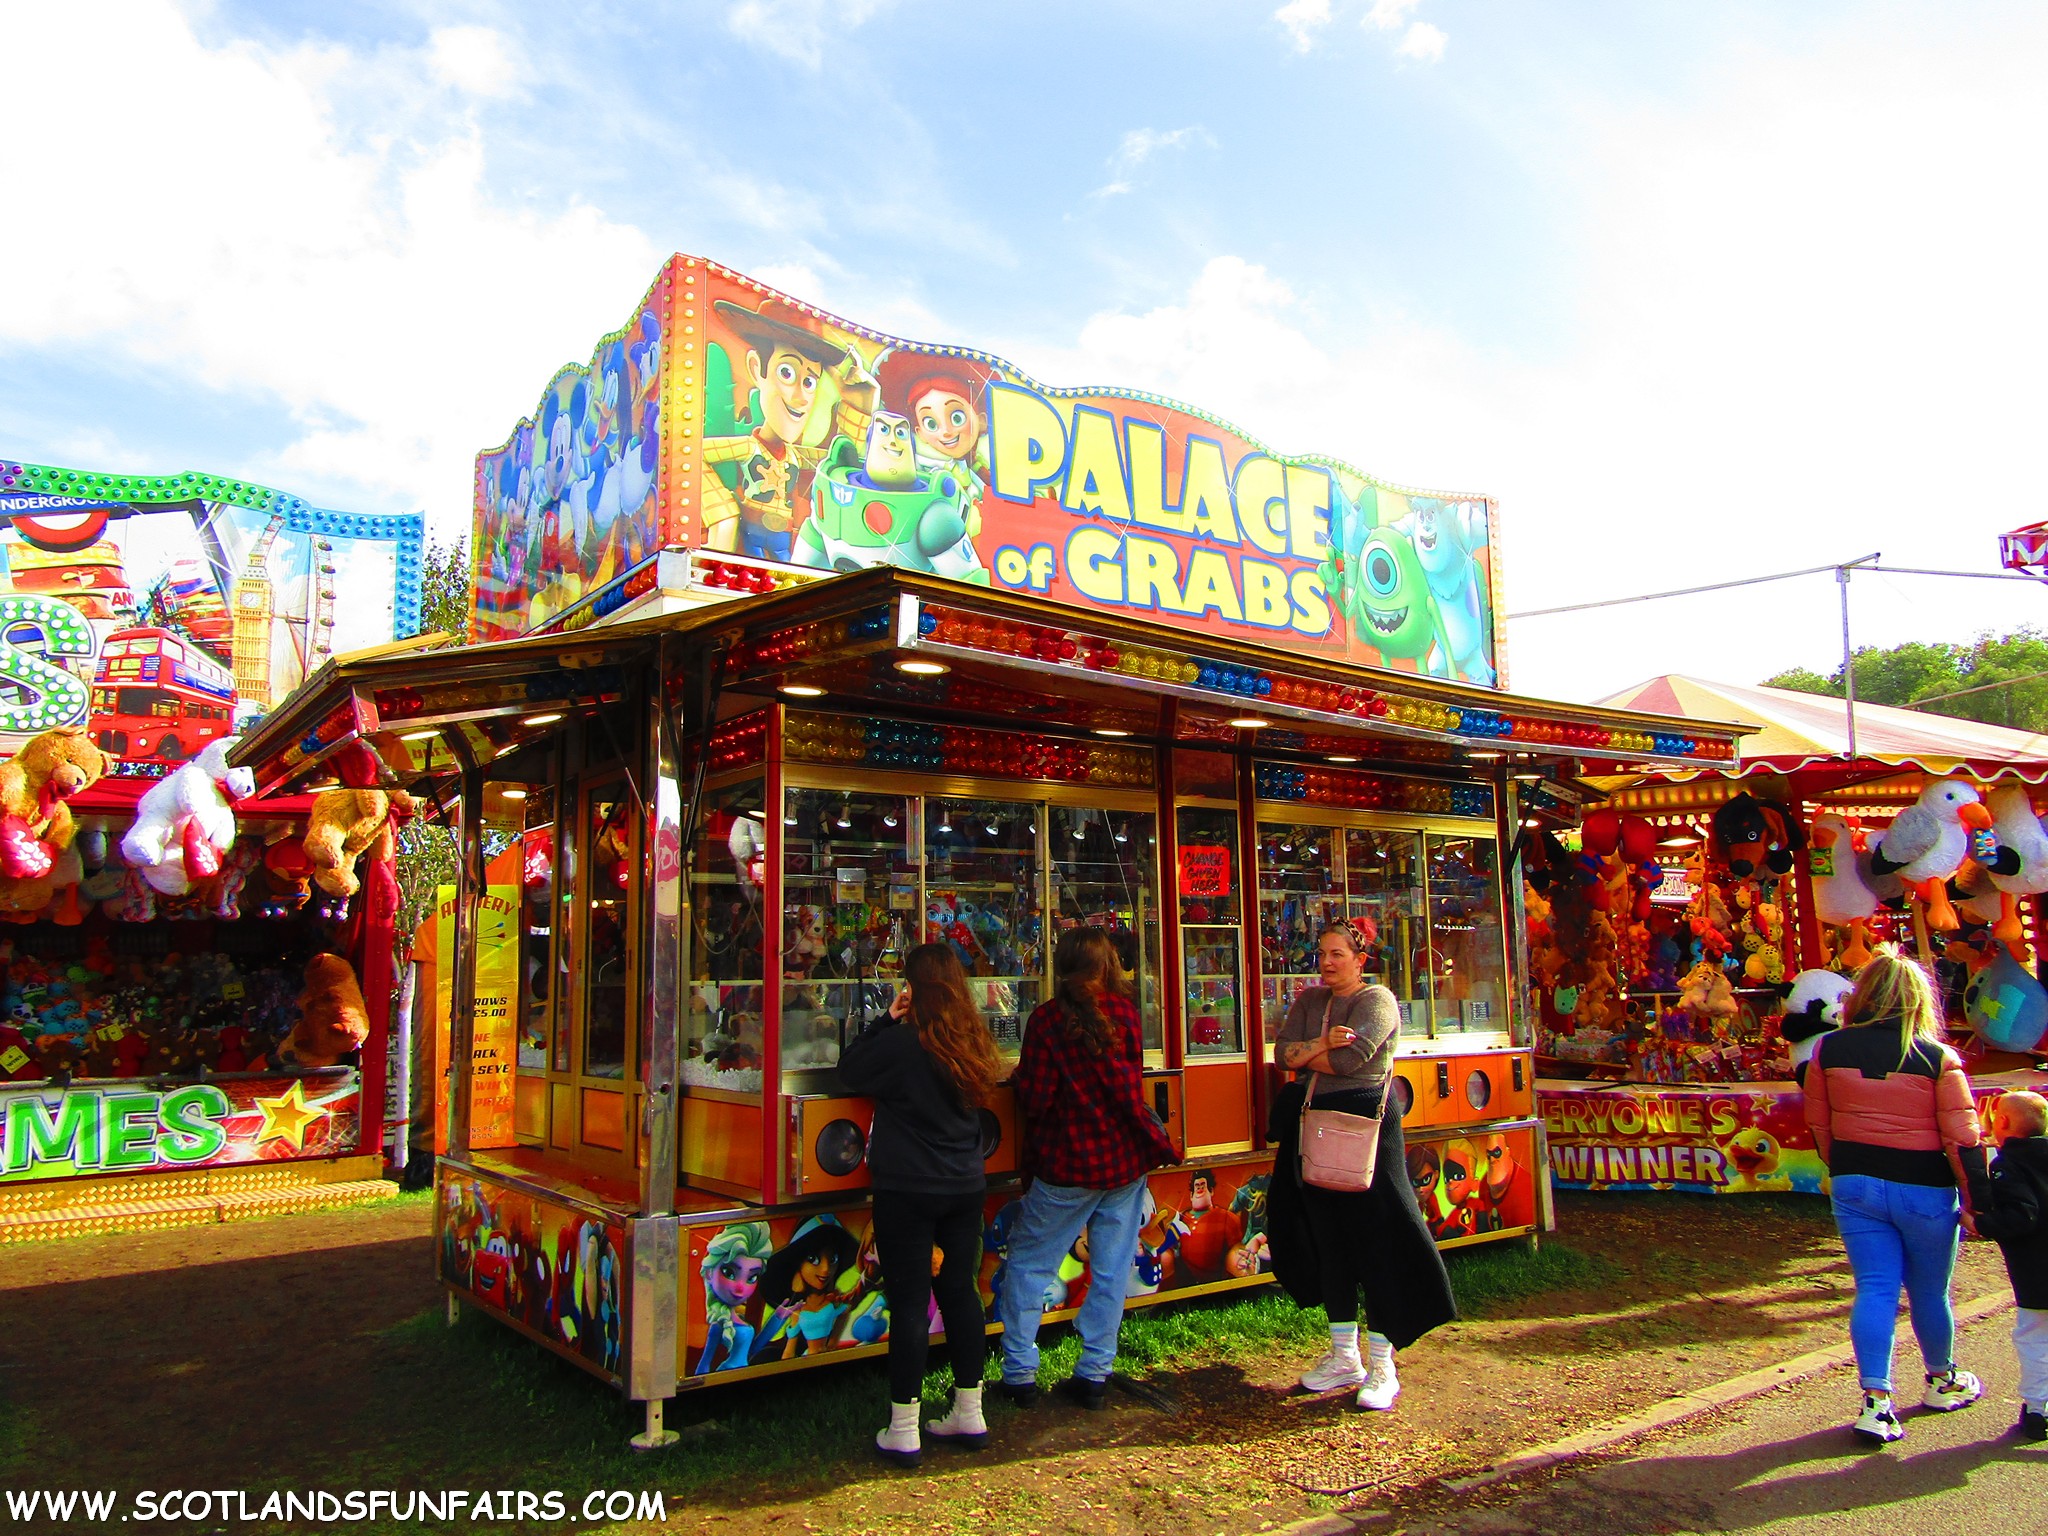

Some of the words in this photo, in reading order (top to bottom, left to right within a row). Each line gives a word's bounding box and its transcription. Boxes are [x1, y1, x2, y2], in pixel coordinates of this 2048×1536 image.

[986, 380, 1332, 563] PALACE
[993, 542, 1055, 593] of
[1064, 523, 1334, 637] GRABS
[1183, 852, 1224, 868] CHANGE
[1191, 879, 1220, 891] HERE
[474, 997, 507, 1006] ROWS
[474, 1032, 491, 1043] NE
[473, 1048, 499, 1059] ACK
[0, 1084, 230, 1174] MES
[1551, 1146, 1729, 1185] WINNER
